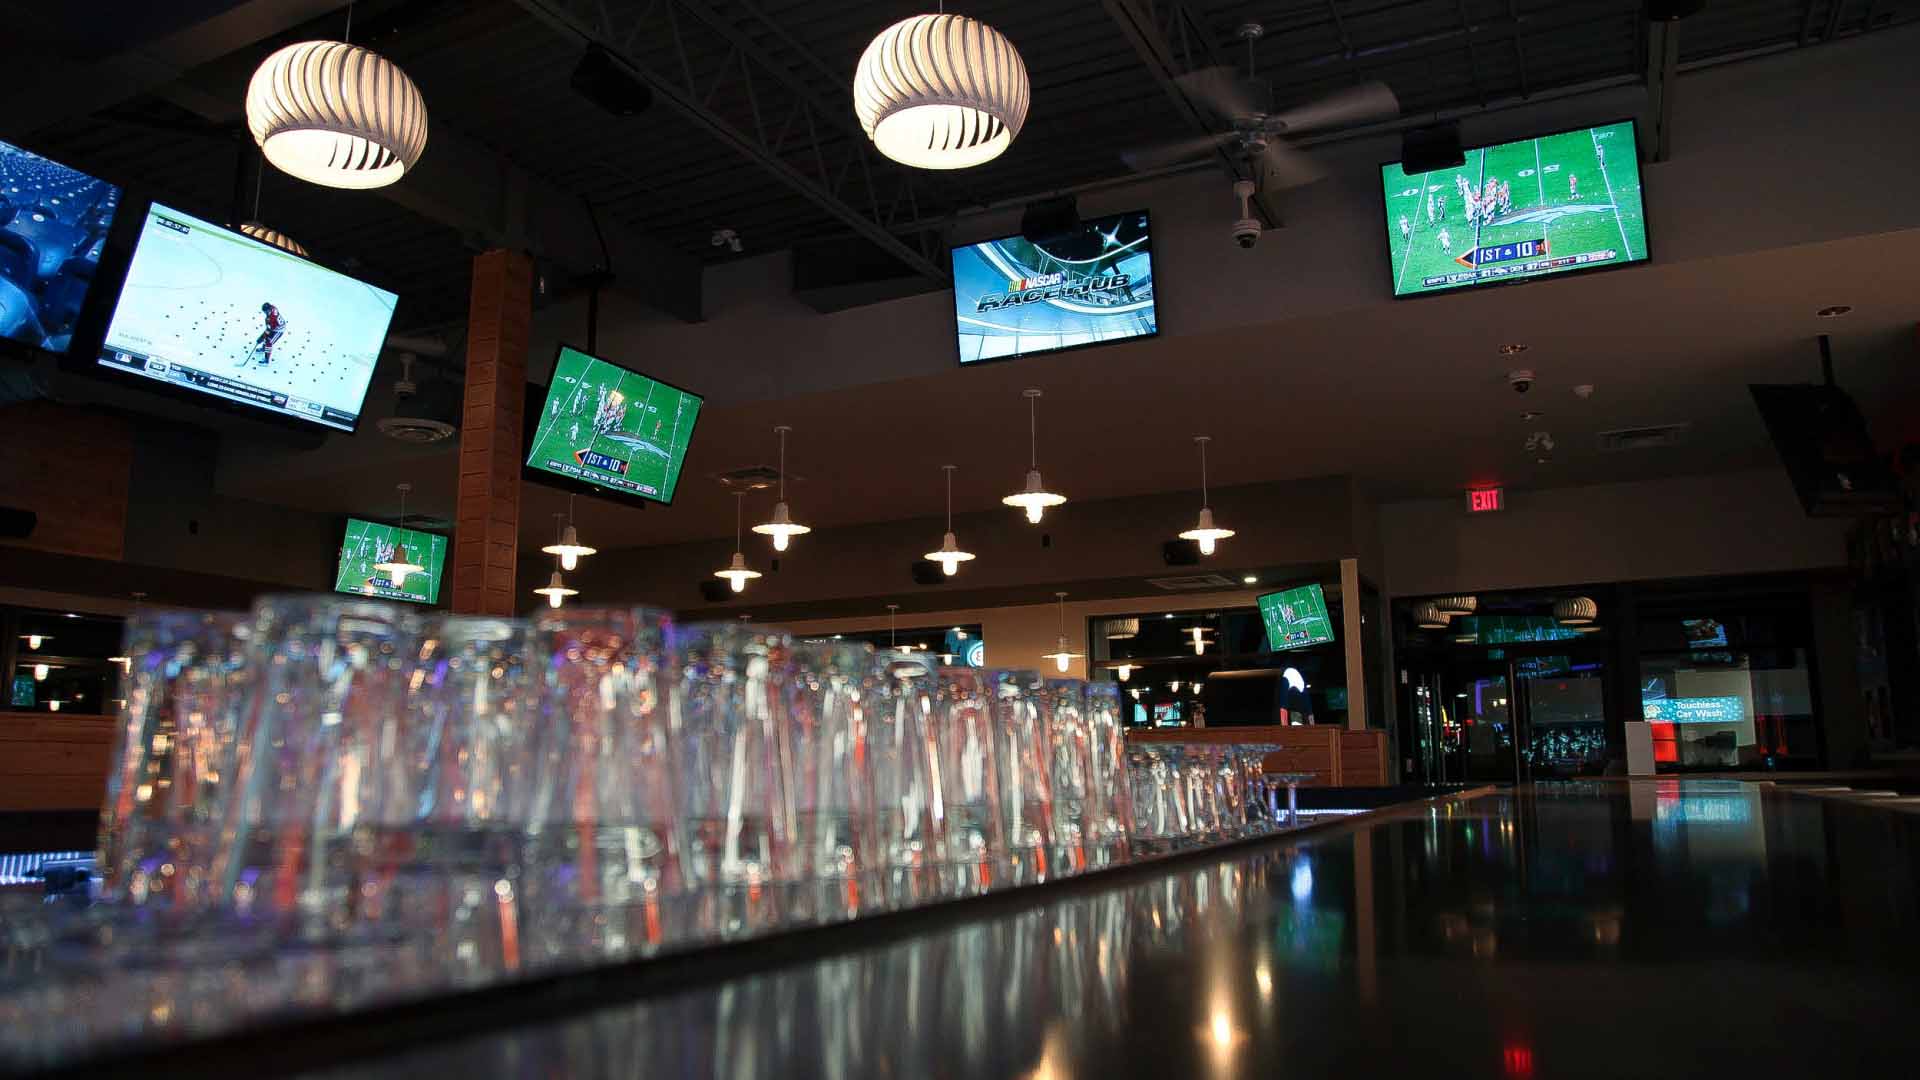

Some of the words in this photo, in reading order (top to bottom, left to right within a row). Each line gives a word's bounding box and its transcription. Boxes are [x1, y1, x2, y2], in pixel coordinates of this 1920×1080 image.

[1516, 241, 1533, 258] 10
[1024, 272, 1062, 290] NASCAR
[976, 284, 1062, 313] RACE
[1062, 273, 1131, 298] HUB
[1471, 490, 1498, 511] EXIT
[1676, 701, 1721, 710] Touchless
[1676, 710, 1693, 718] Car
[1695, 709, 1723, 718] Wash
